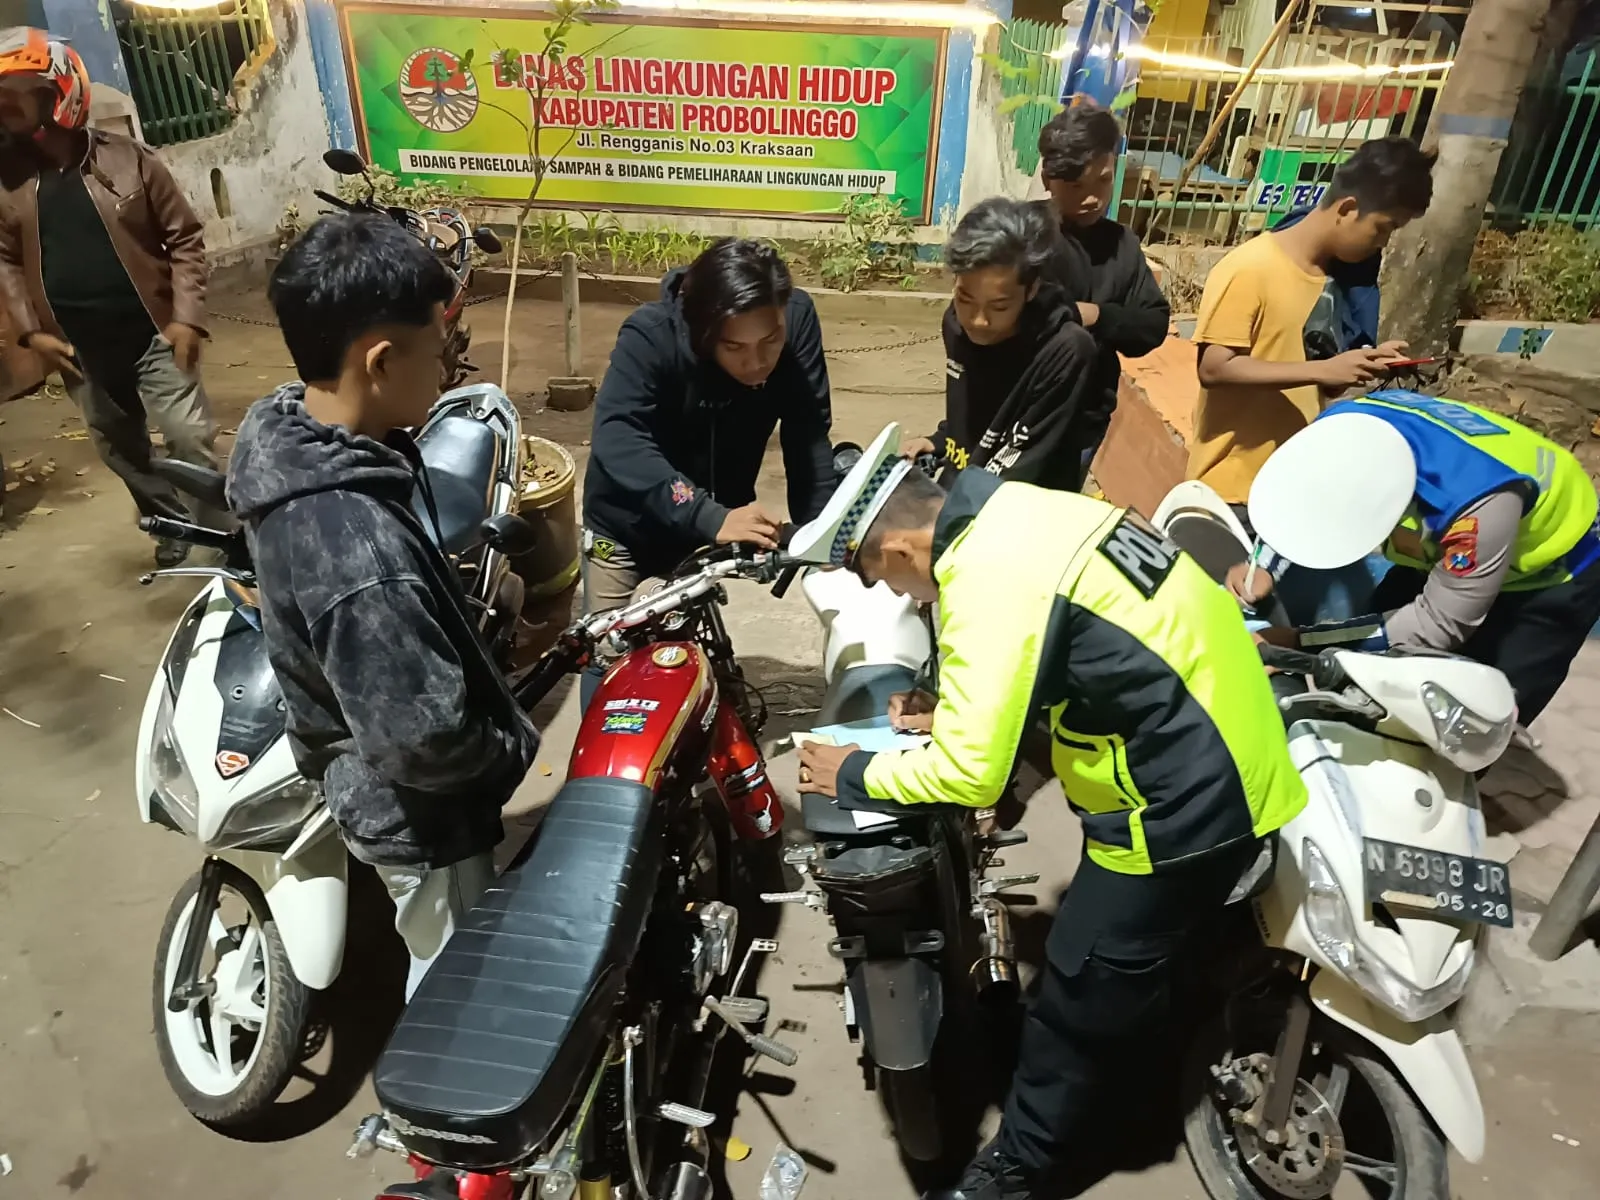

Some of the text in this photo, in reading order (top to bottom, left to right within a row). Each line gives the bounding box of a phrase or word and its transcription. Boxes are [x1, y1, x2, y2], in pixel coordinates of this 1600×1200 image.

[594, 57, 789, 100] LINGKUNGAN
[799, 67, 895, 104] HIDUP
[533, 97, 857, 139] KABUPATEN PROBOLINGGO
[600, 134, 684, 153] Rengganis
[690, 138, 735, 154] No.03
[740, 140, 813, 157] Kraksaan
[410, 154, 456, 170] BIDANG
[550, 160, 601, 176] SAMPAH
[605, 163, 614, 177] &
[618, 163, 664, 179] BIDANG
[668, 166, 763, 184] PEMELIHARAAN
[767, 171, 844, 187] LINGKUNGAN
[848, 174, 886, 188] HIDUP
[1257, 184, 1285, 205] ES
[1366, 843, 1505, 895] N 6398 JR
